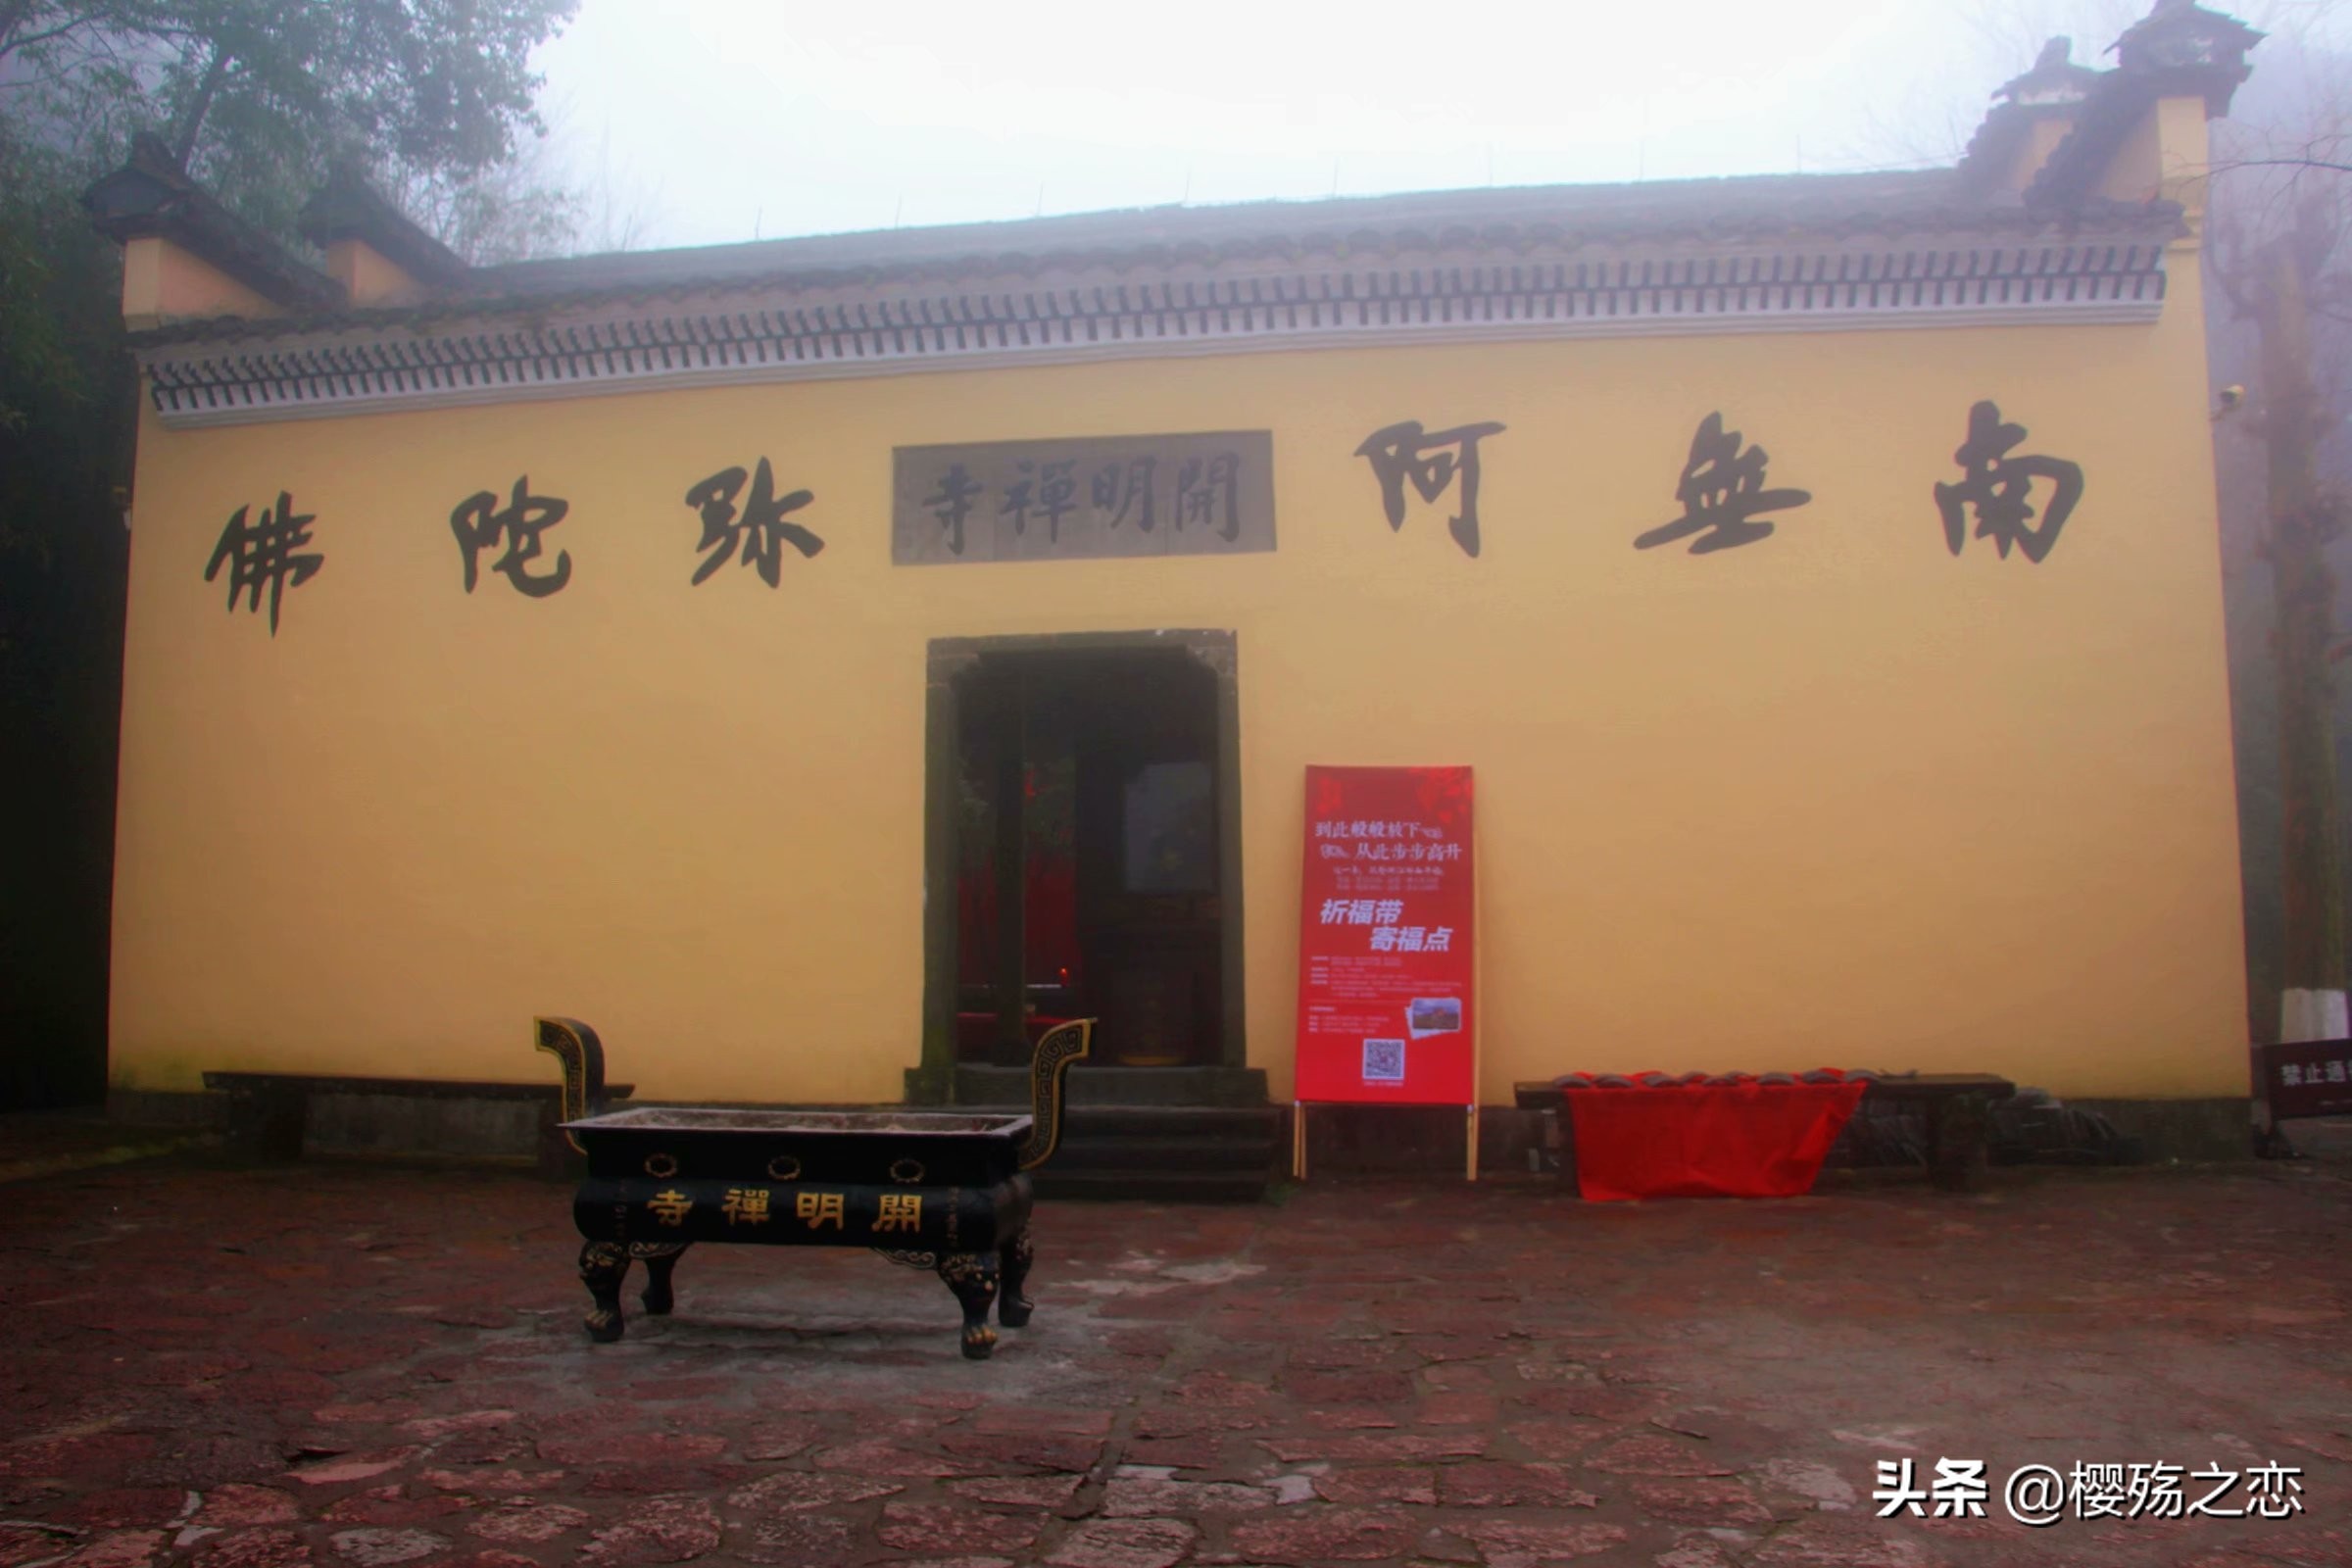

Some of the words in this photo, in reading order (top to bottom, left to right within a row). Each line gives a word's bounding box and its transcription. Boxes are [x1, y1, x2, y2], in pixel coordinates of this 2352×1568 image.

[1319, 899, 1404, 925] 祈福带
[1369, 925, 1453, 953] 寄福点
